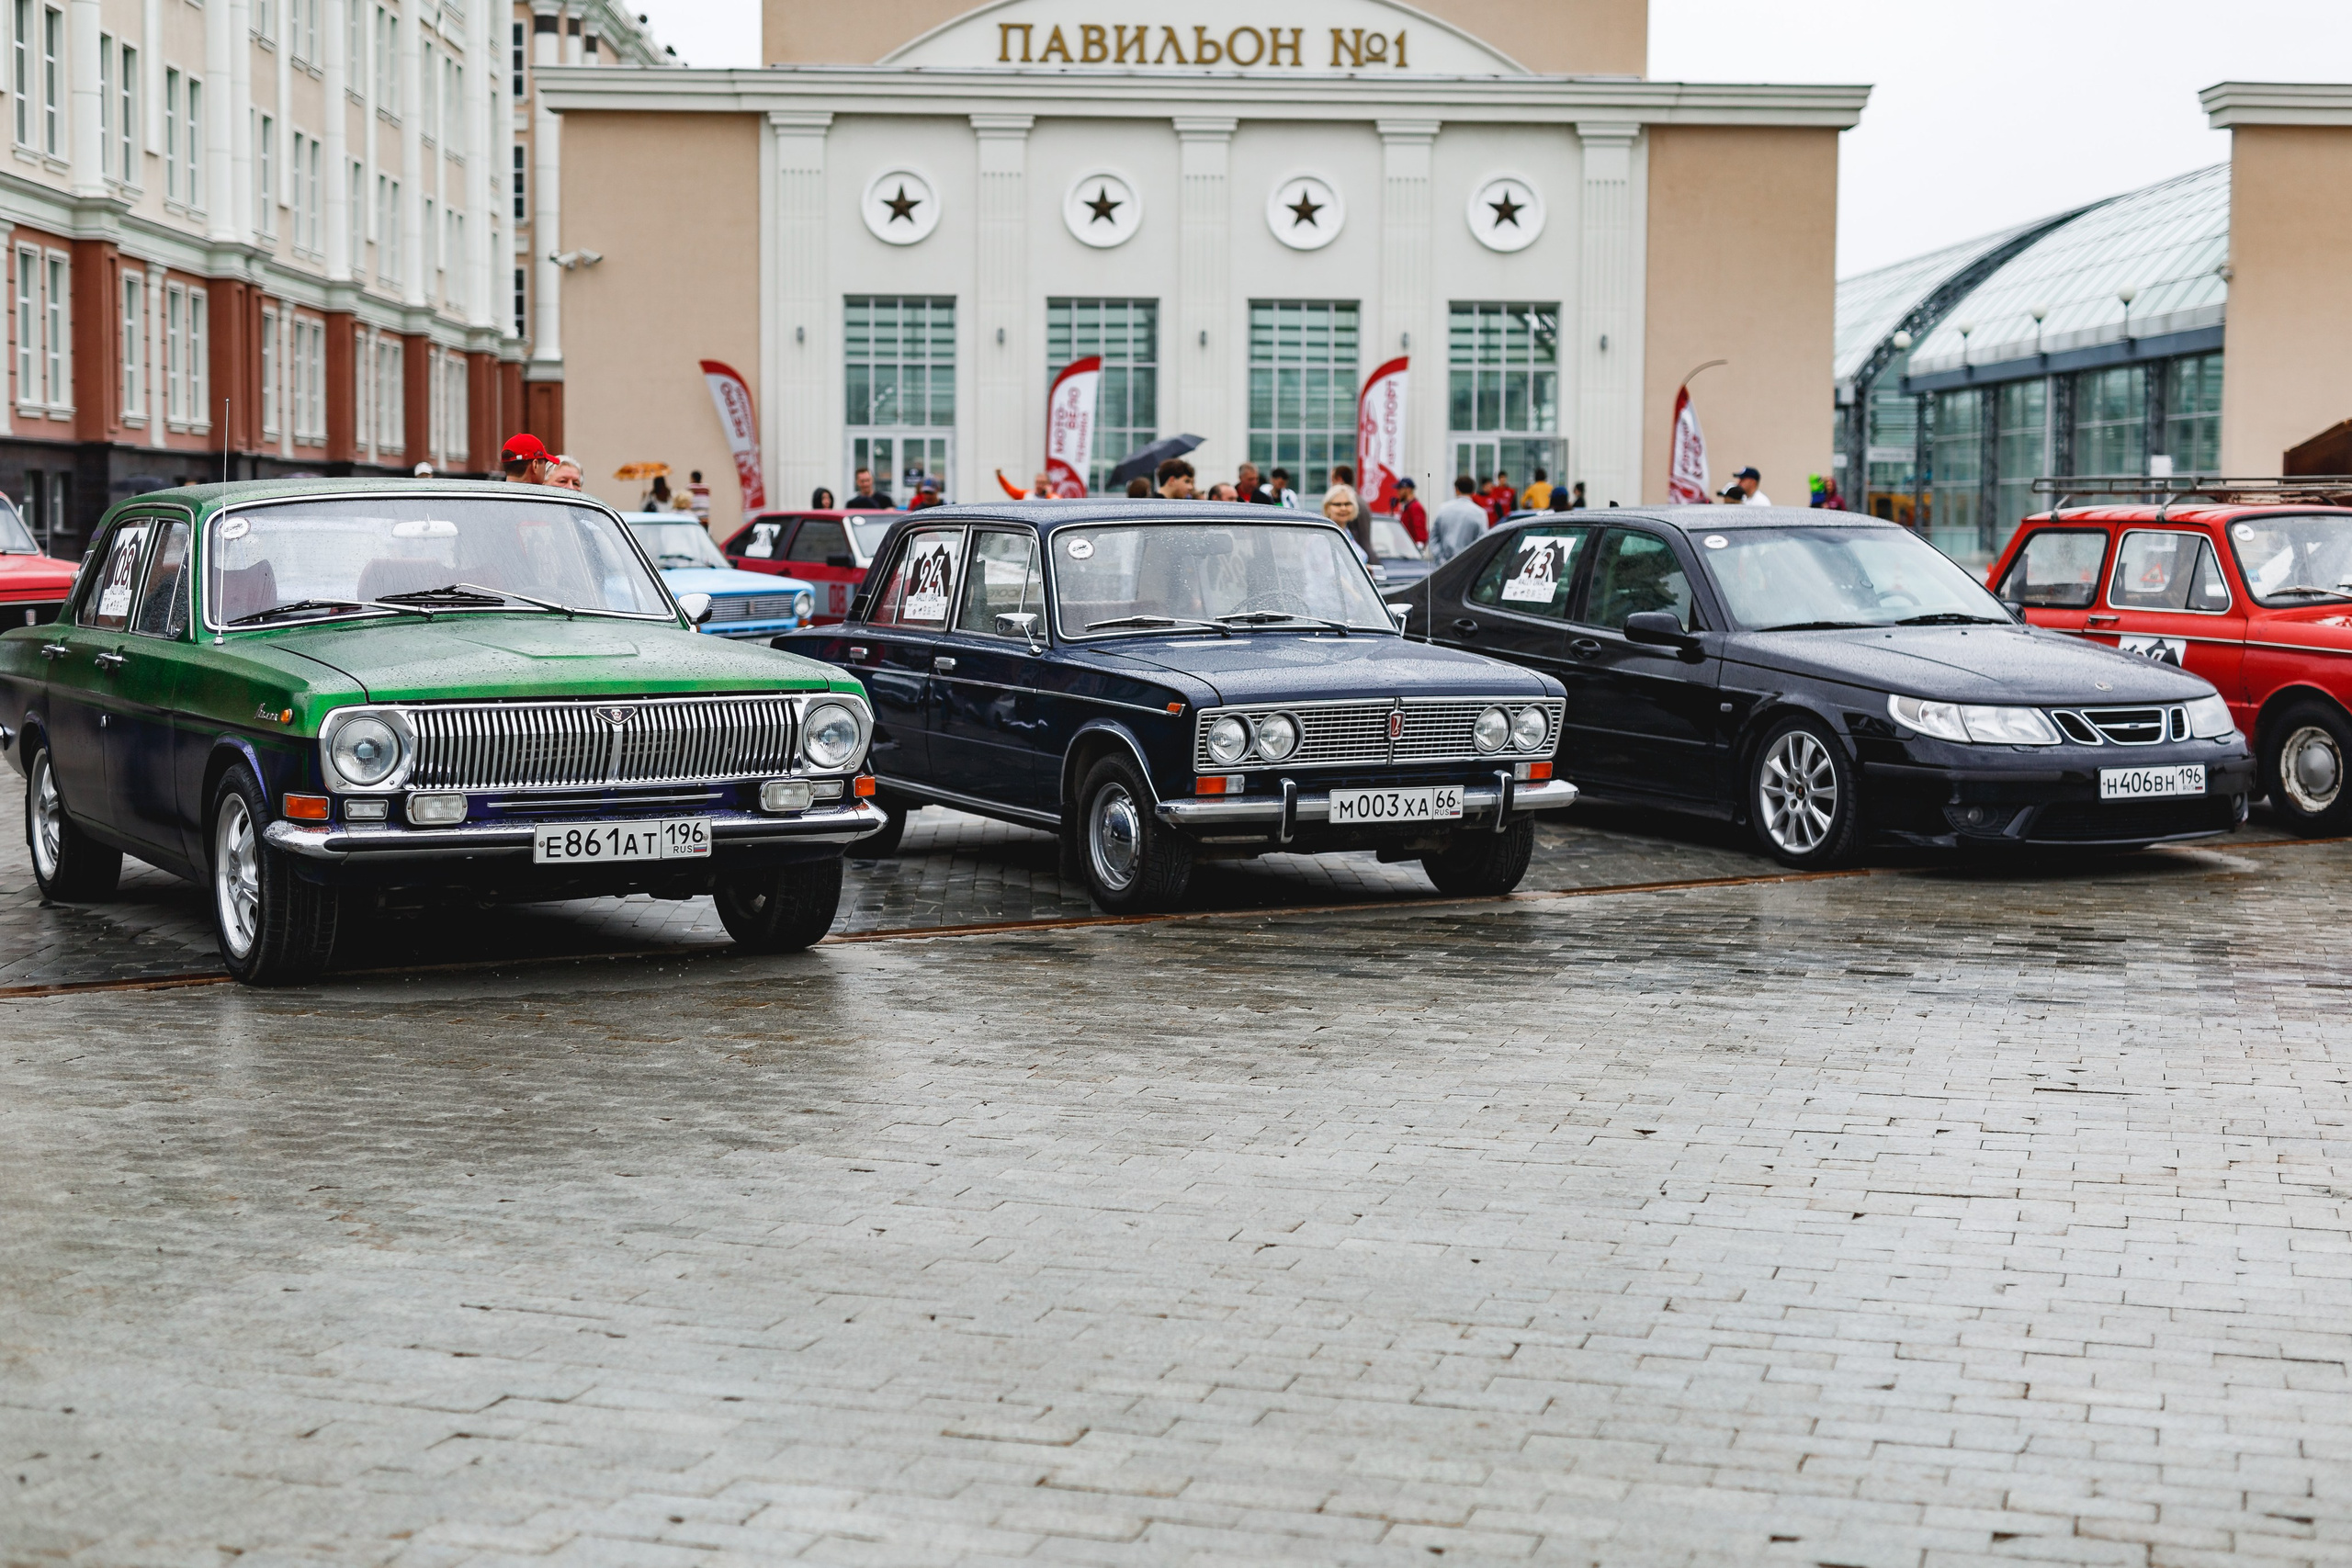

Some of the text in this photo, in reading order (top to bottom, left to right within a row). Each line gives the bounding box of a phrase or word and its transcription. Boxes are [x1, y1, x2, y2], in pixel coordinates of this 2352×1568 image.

[997, 22, 1410, 69] ПАВИЛЬОН №1
[114, 544, 136, 585] 08
[920, 558, 943, 593] 24
[1524, 550, 1552, 579] 43
[2107, 767, 2201, 795] Н406ВН 196
[1340, 790, 1456, 818] М003ХА 66
[546, 822, 704, 858] Е861АТ 196
[673, 844, 693, 853] RUS
